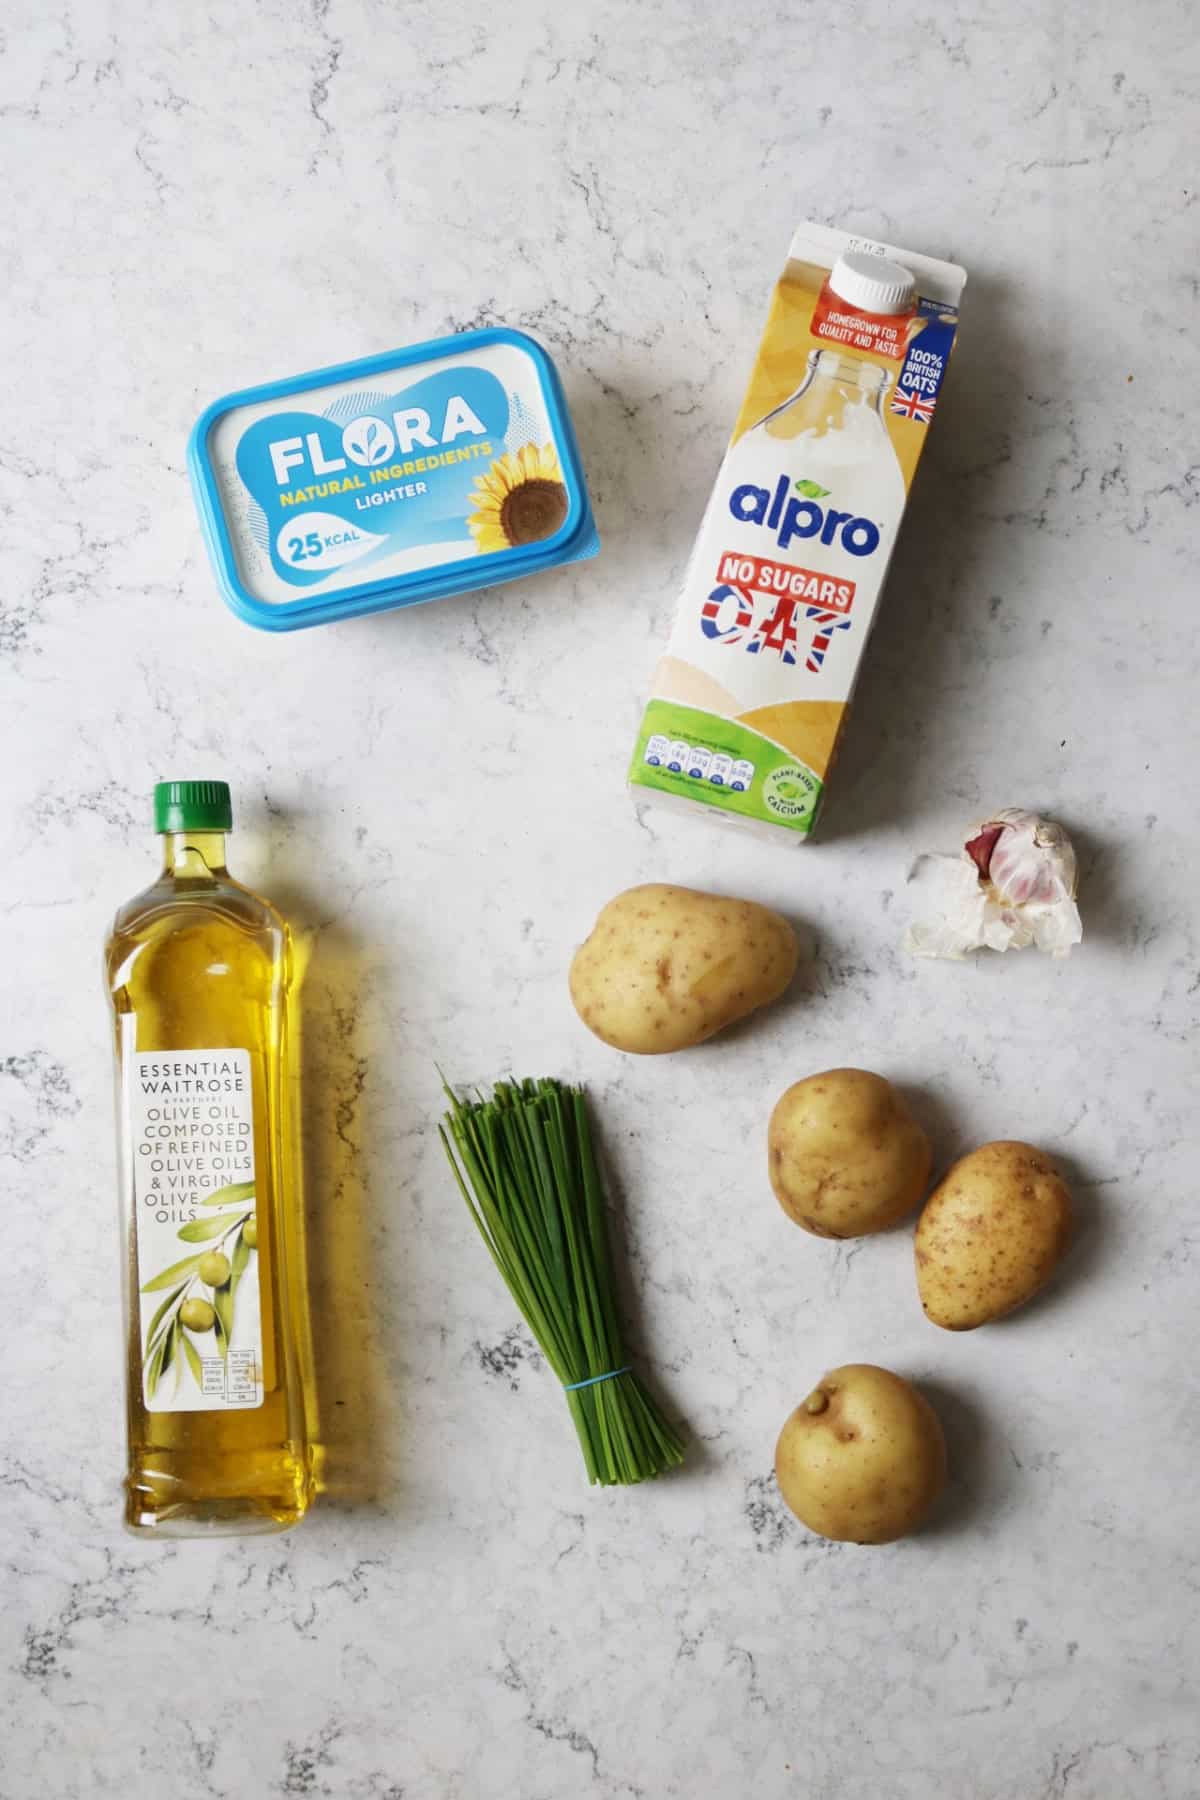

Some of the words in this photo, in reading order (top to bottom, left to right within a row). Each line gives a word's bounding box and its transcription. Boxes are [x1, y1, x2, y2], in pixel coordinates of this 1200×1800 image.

[827, 311, 880, 336] HOMEGROWN
[881, 327, 898, 341] FOR
[819, 322, 853, 342] QUALITY
[854, 333, 872, 347] AND
[874, 338, 900, 356] TASTE
[910, 348, 943, 368] 100%
[906, 361, 941, 380] BRITISH
[902, 372, 938, 394] OATS
[268, 395, 487, 486] FLORA
[369, 442, 493, 485] INGREDIENTS
[279, 475, 366, 508] NATURAL
[355, 482, 428, 511] LIGHTER
[729, 474, 880, 557] alpro
[288, 533, 323, 562] 25
[325, 530, 361, 547] KCAL
[721, 557, 755, 583] NO
[757, 565, 851, 607] SUGARS
[701, 584, 852, 673] OAT
[767, 795, 805, 815] CALCIUM
[140, 1062, 243, 1078] ESSENTIAL
[141, 1079, 244, 1094] WAITROSE
[147, 1106, 201, 1121] OLIVE
[208, 1105, 240, 1119] OIL
[144, 1122, 250, 1138] COMPOSED
[139, 1142, 163, 1156] OF
[168, 1139, 248, 1154] REFINED
[151, 1158, 205, 1172] OLIVE
[211, 1156, 251, 1170] OILS
[151, 1176, 161, 1190] &
[167, 1174, 233, 1188] VIRGIN
[144, 1192, 199, 1207] OLIVE
[155, 1209, 197, 1223] OILS
